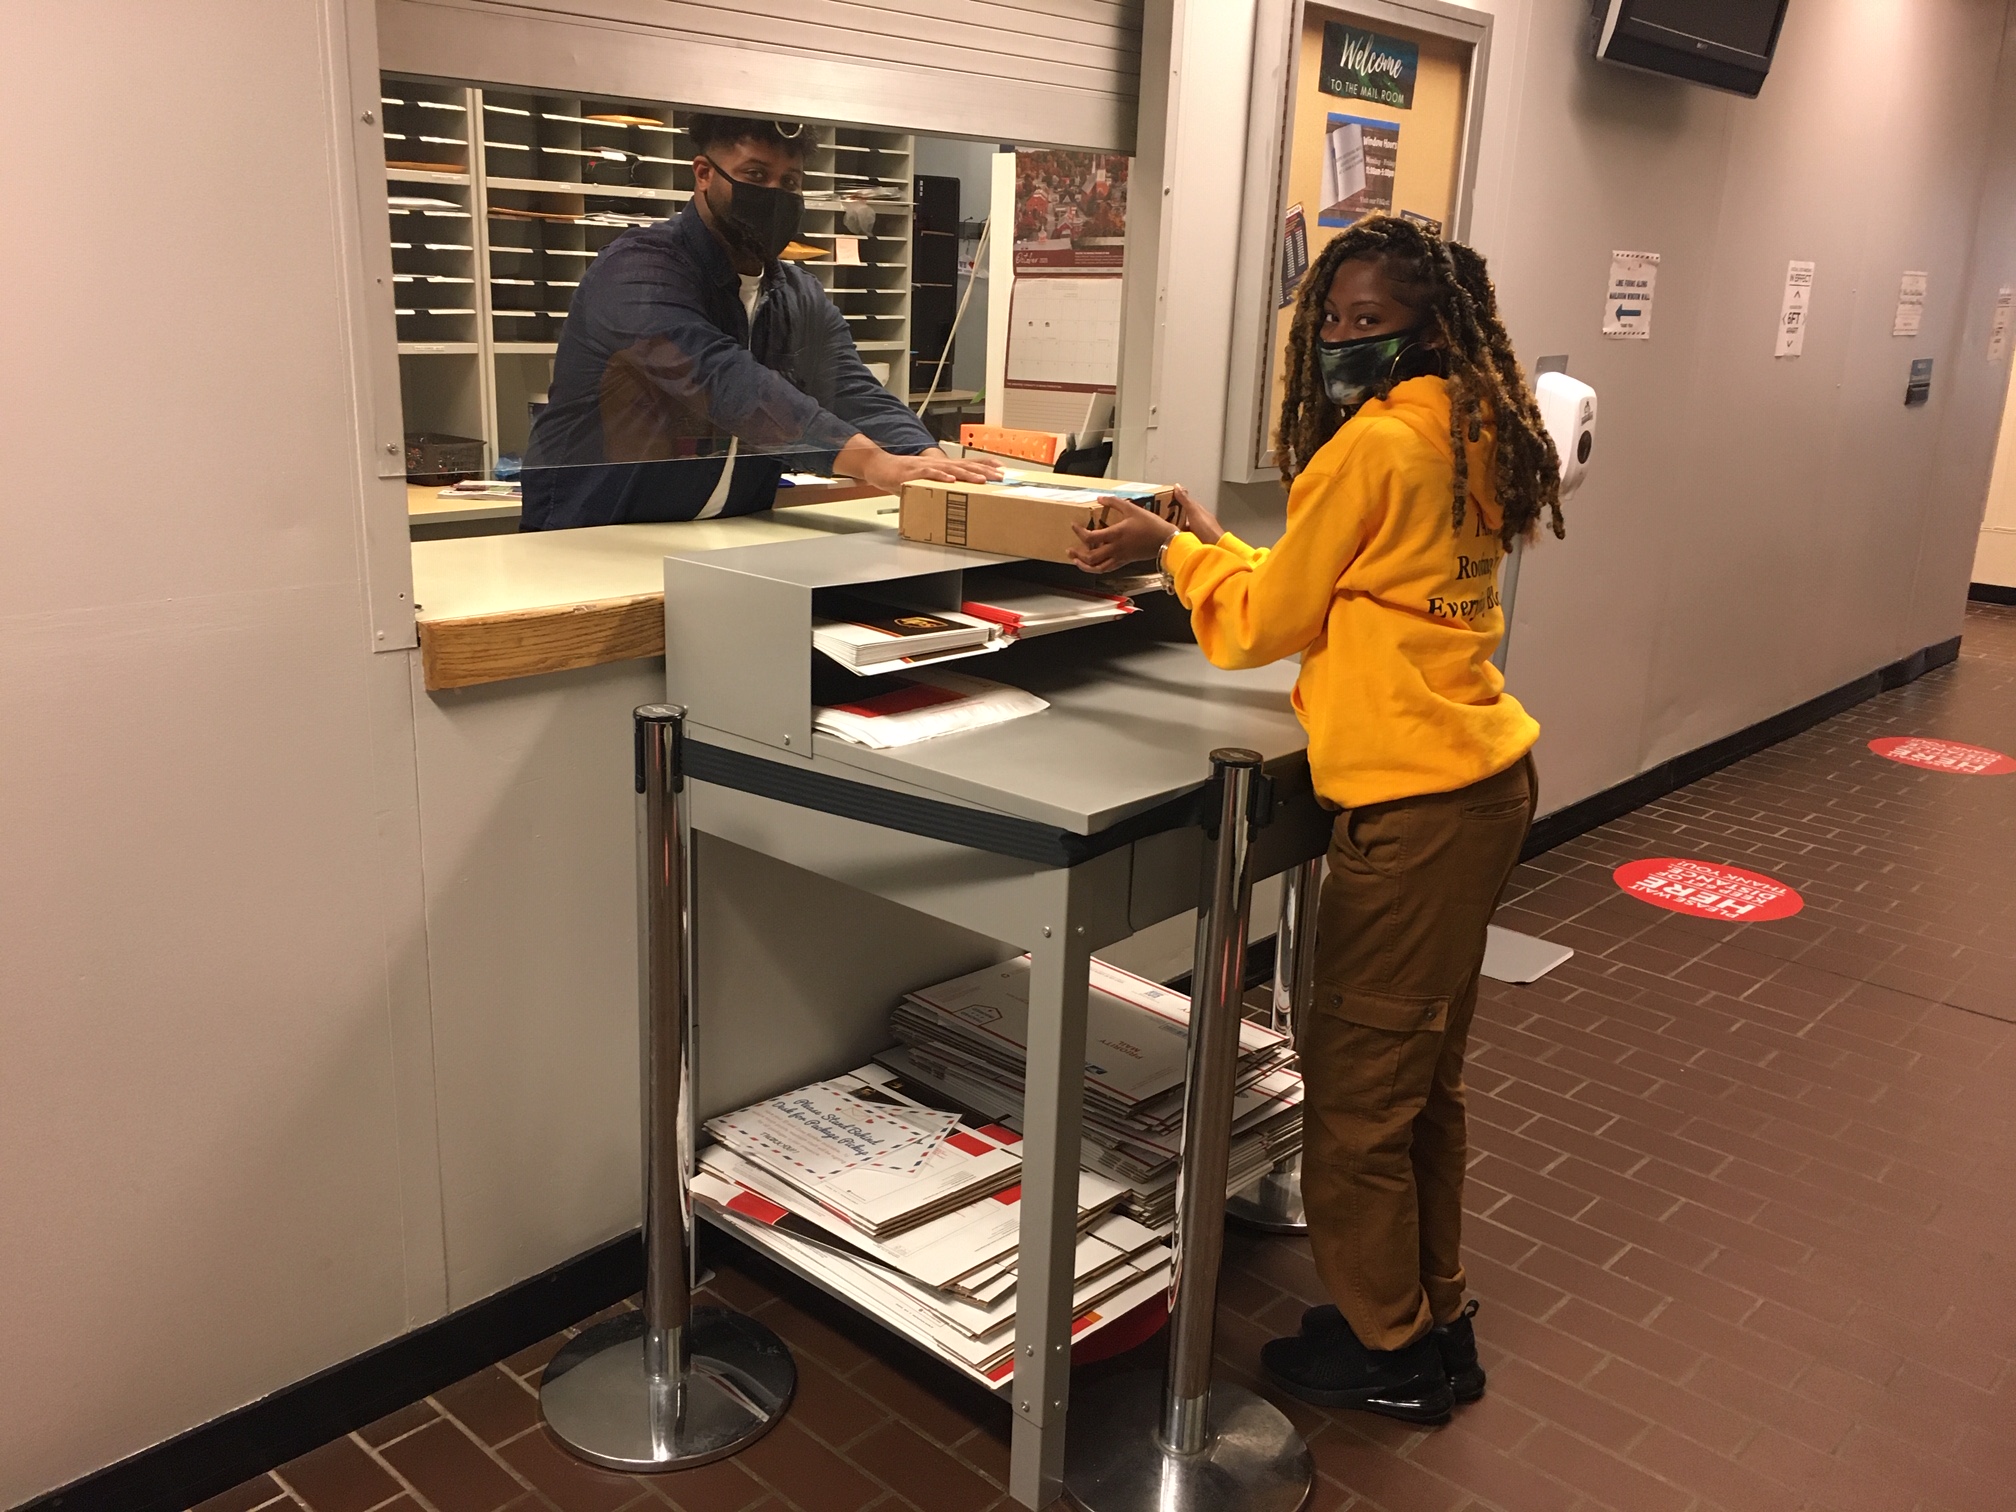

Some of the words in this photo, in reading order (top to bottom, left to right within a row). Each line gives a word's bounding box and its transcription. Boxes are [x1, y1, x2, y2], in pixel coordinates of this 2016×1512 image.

[1340, 32, 1403, 78] Welcome
[1330, 78, 1342, 91] TO
[1345, 81, 1358, 95] THE
[1360, 86, 1378, 99] MAIL
[1381, 89, 1404, 104] ROOM
[1656, 871, 1684, 881] OF
[1678, 861, 1720, 877] YOU!
[1628, 884, 1672, 900] WAIT
[1686, 878, 1719, 890] 6FT
[1727, 873, 1787, 895] THANK
[1636, 876, 1755, 914] HERE
[1718, 887, 1768, 905] KEEP
[1673, 894, 1740, 918] PLEASE
[1098, 1039, 1144, 1060] PRIORITY
[1118, 1041, 1142, 1053] MAIL
[772, 1101, 798, 1114] Desk
[788, 1111, 807, 1121] for
[804, 1119, 840, 1140] Package
[837, 1137, 869, 1156] Pickup
[793, 1098, 822, 1116] Please
[821, 1113, 854, 1130] Stand
[847, 1126, 885, 1146] Behind
